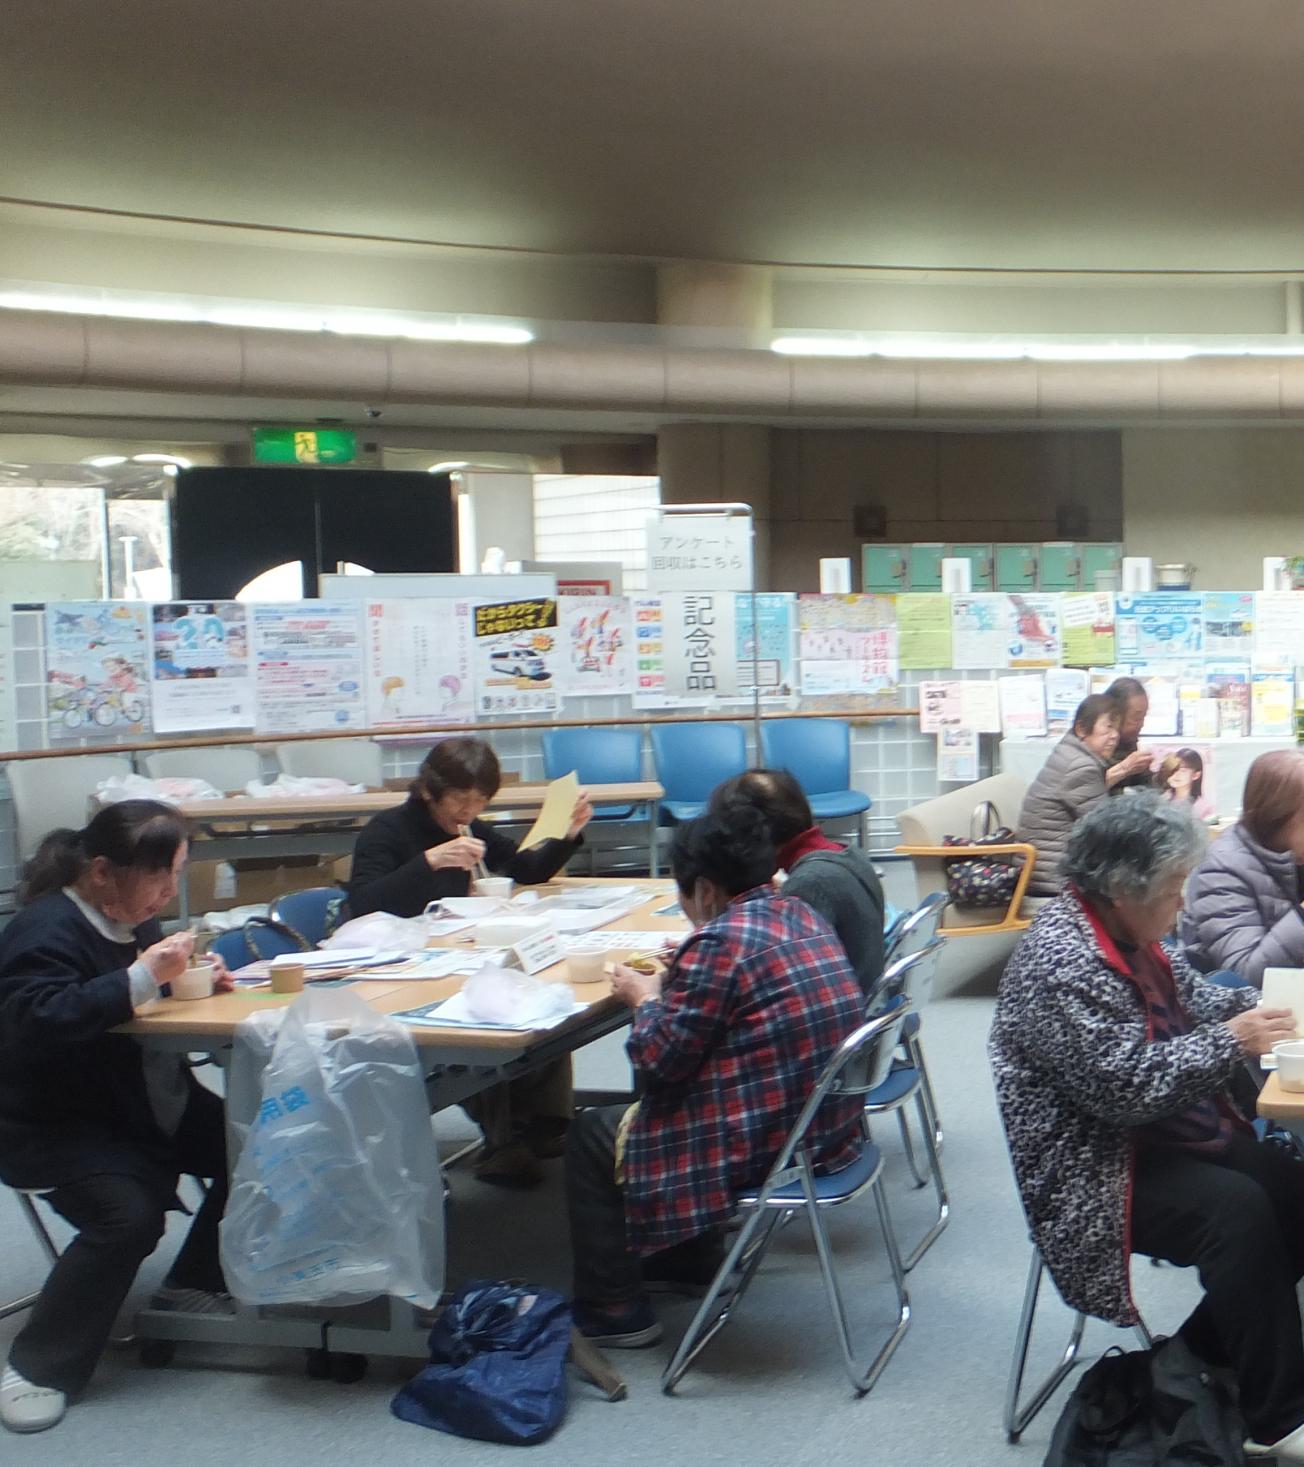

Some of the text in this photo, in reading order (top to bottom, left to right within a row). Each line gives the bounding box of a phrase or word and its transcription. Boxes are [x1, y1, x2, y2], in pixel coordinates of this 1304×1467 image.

[660, 536, 734, 549] アンケート
[651, 556, 743, 570] 回収はこちら
[683, 596, 716, 691] 記念品
